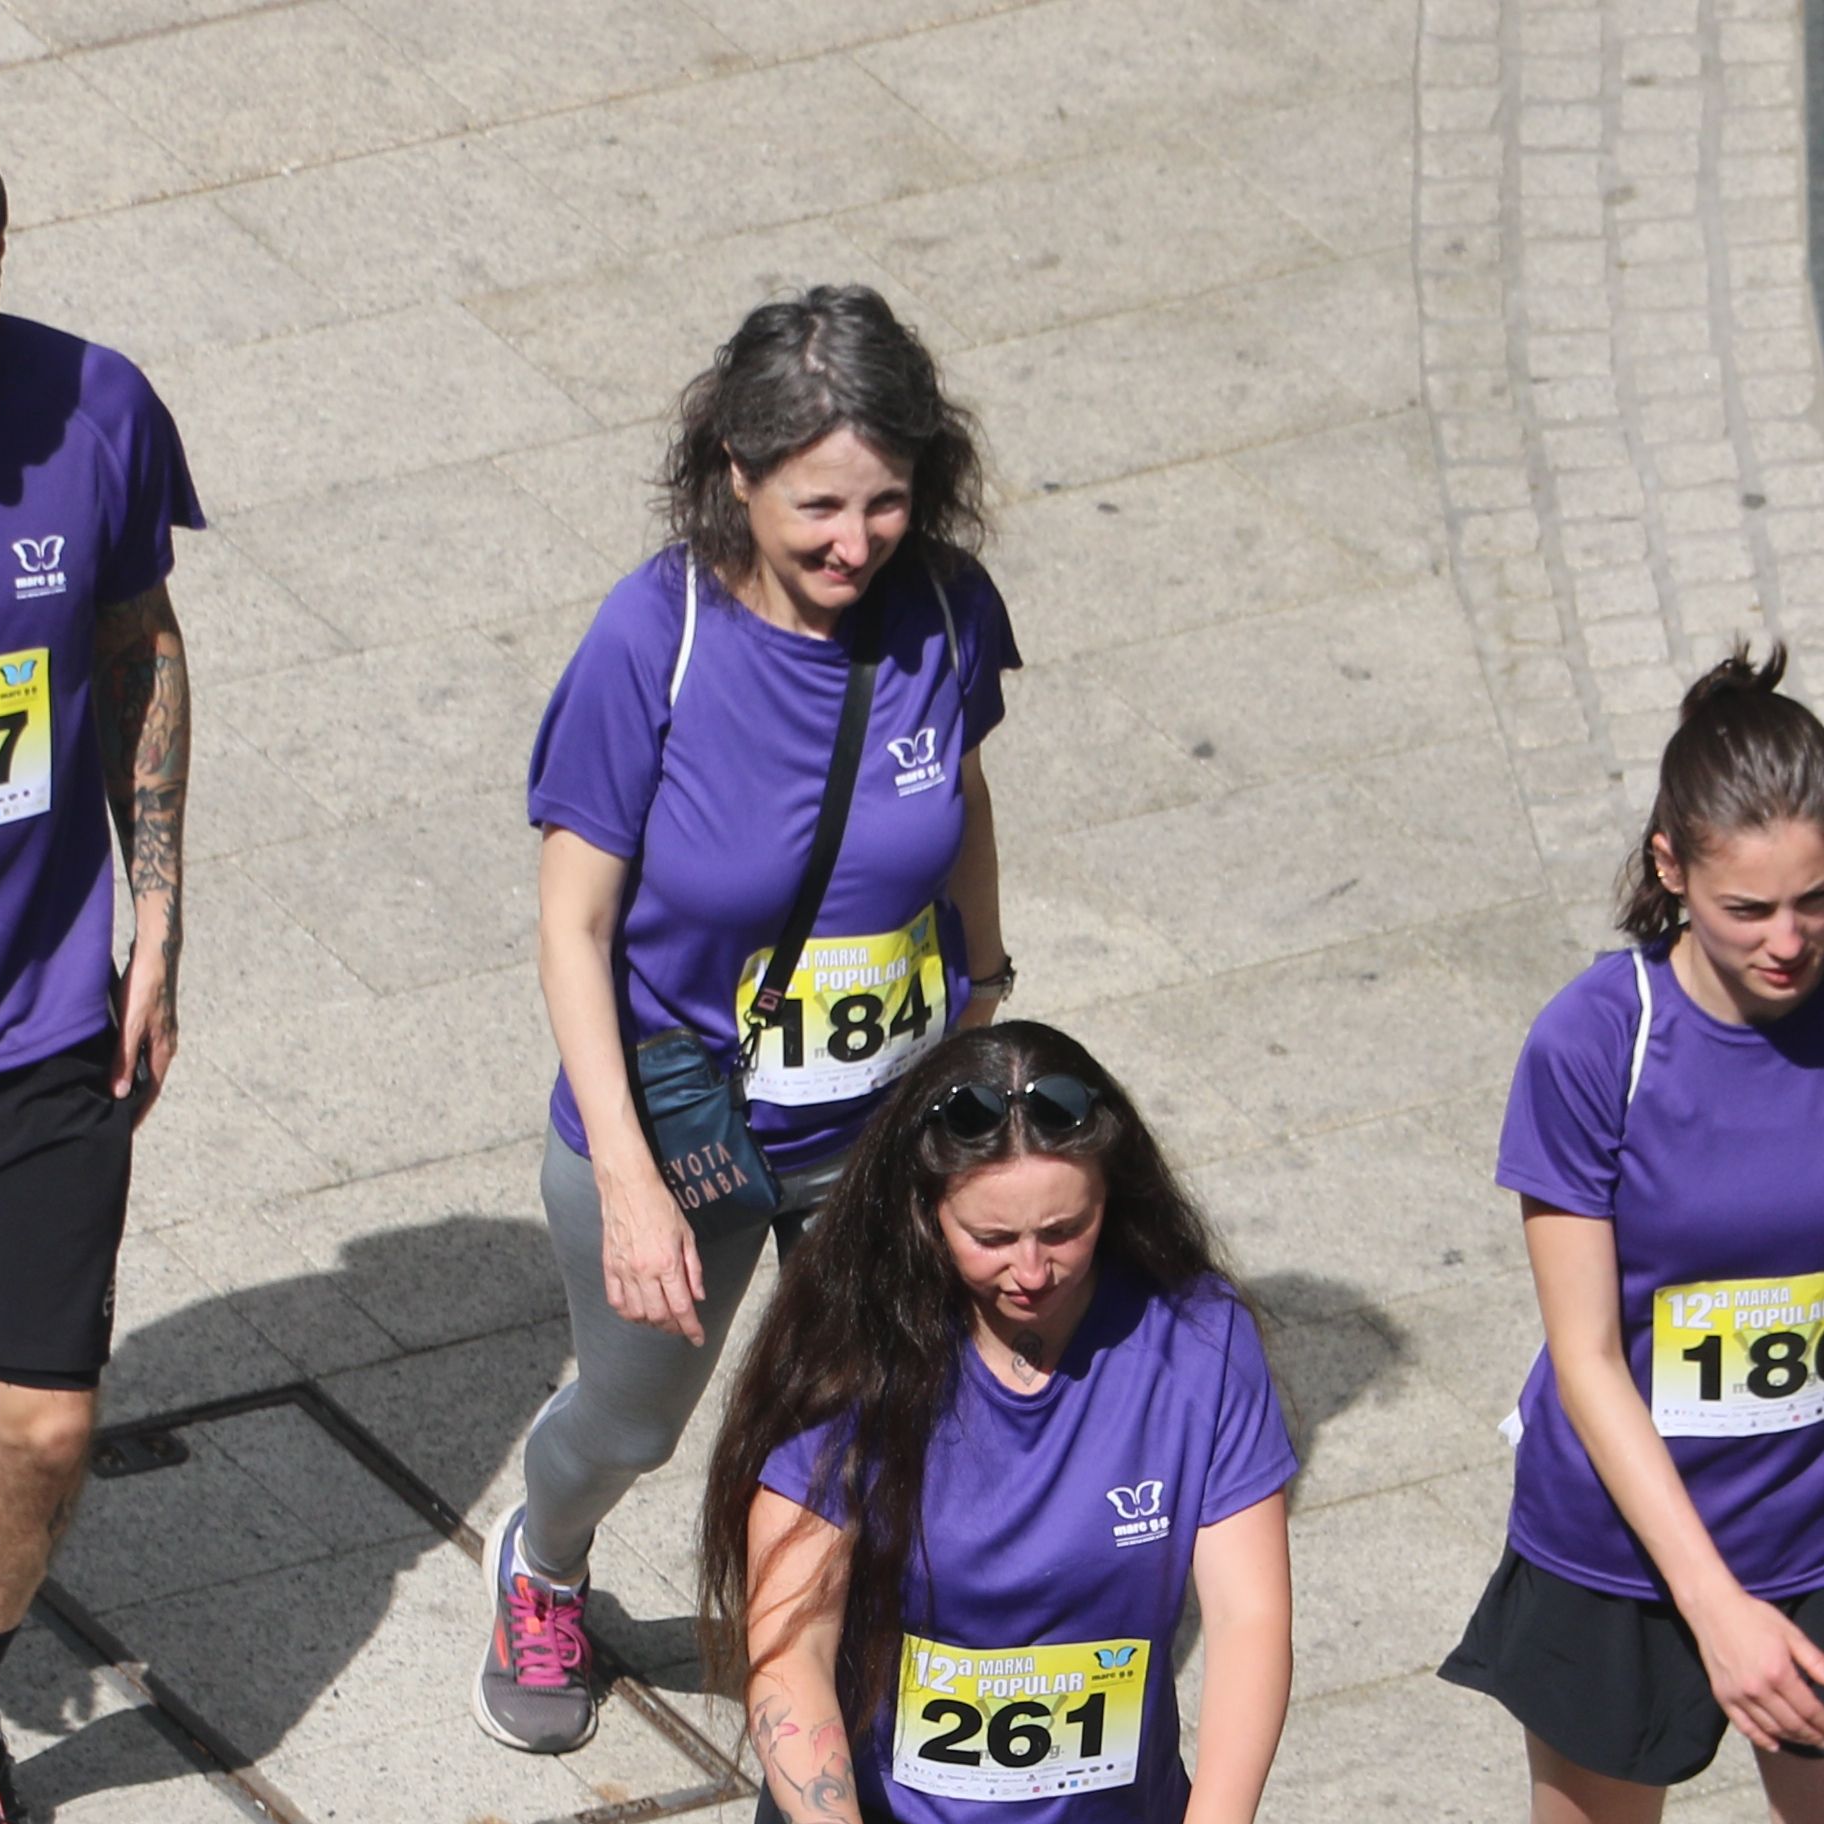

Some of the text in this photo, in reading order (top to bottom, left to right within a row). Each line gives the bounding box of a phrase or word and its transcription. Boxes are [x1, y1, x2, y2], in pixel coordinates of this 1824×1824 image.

[814, 947, 868, 967] MARXA
[814, 957, 908, 992] POPULAR
[771, 969, 932, 1068] 184
[1734, 1287, 1790, 1307] MARXA
[1113, 1521, 1147, 1537] marc
[979, 1656, 1034, 1677] MARXA
[977, 1672, 1084, 1698] POPULAR
[918, 1692, 1106, 1768] 261
